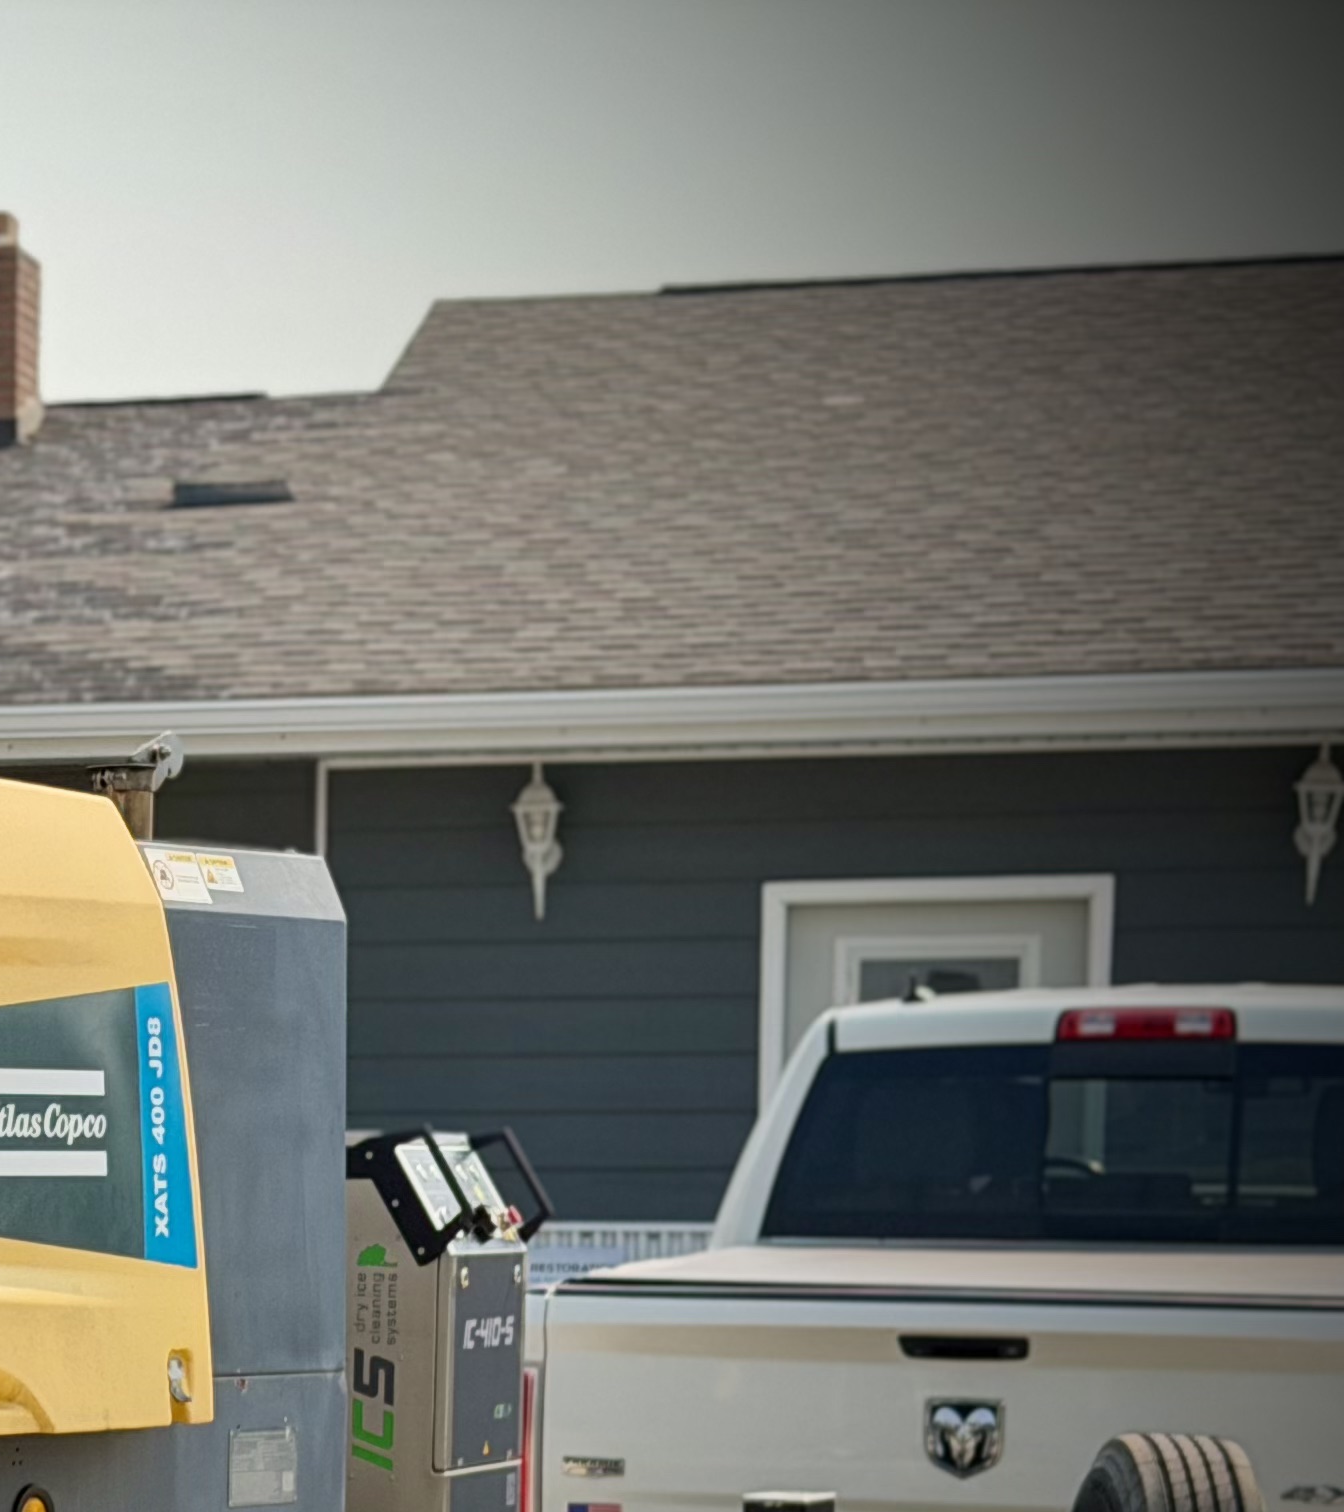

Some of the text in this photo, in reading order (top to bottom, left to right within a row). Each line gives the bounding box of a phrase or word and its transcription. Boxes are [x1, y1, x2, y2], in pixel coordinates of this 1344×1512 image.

[43, 1103, 107, 1146] Copco
[147, 1017, 169, 1238] XATS 400 JD8
[353, 1272, 368, 1332] dry ice
[370, 1272, 385, 1344] cleaning
[387, 1273, 400, 1345] systems
[352, 1347, 396, 1472] ICS
